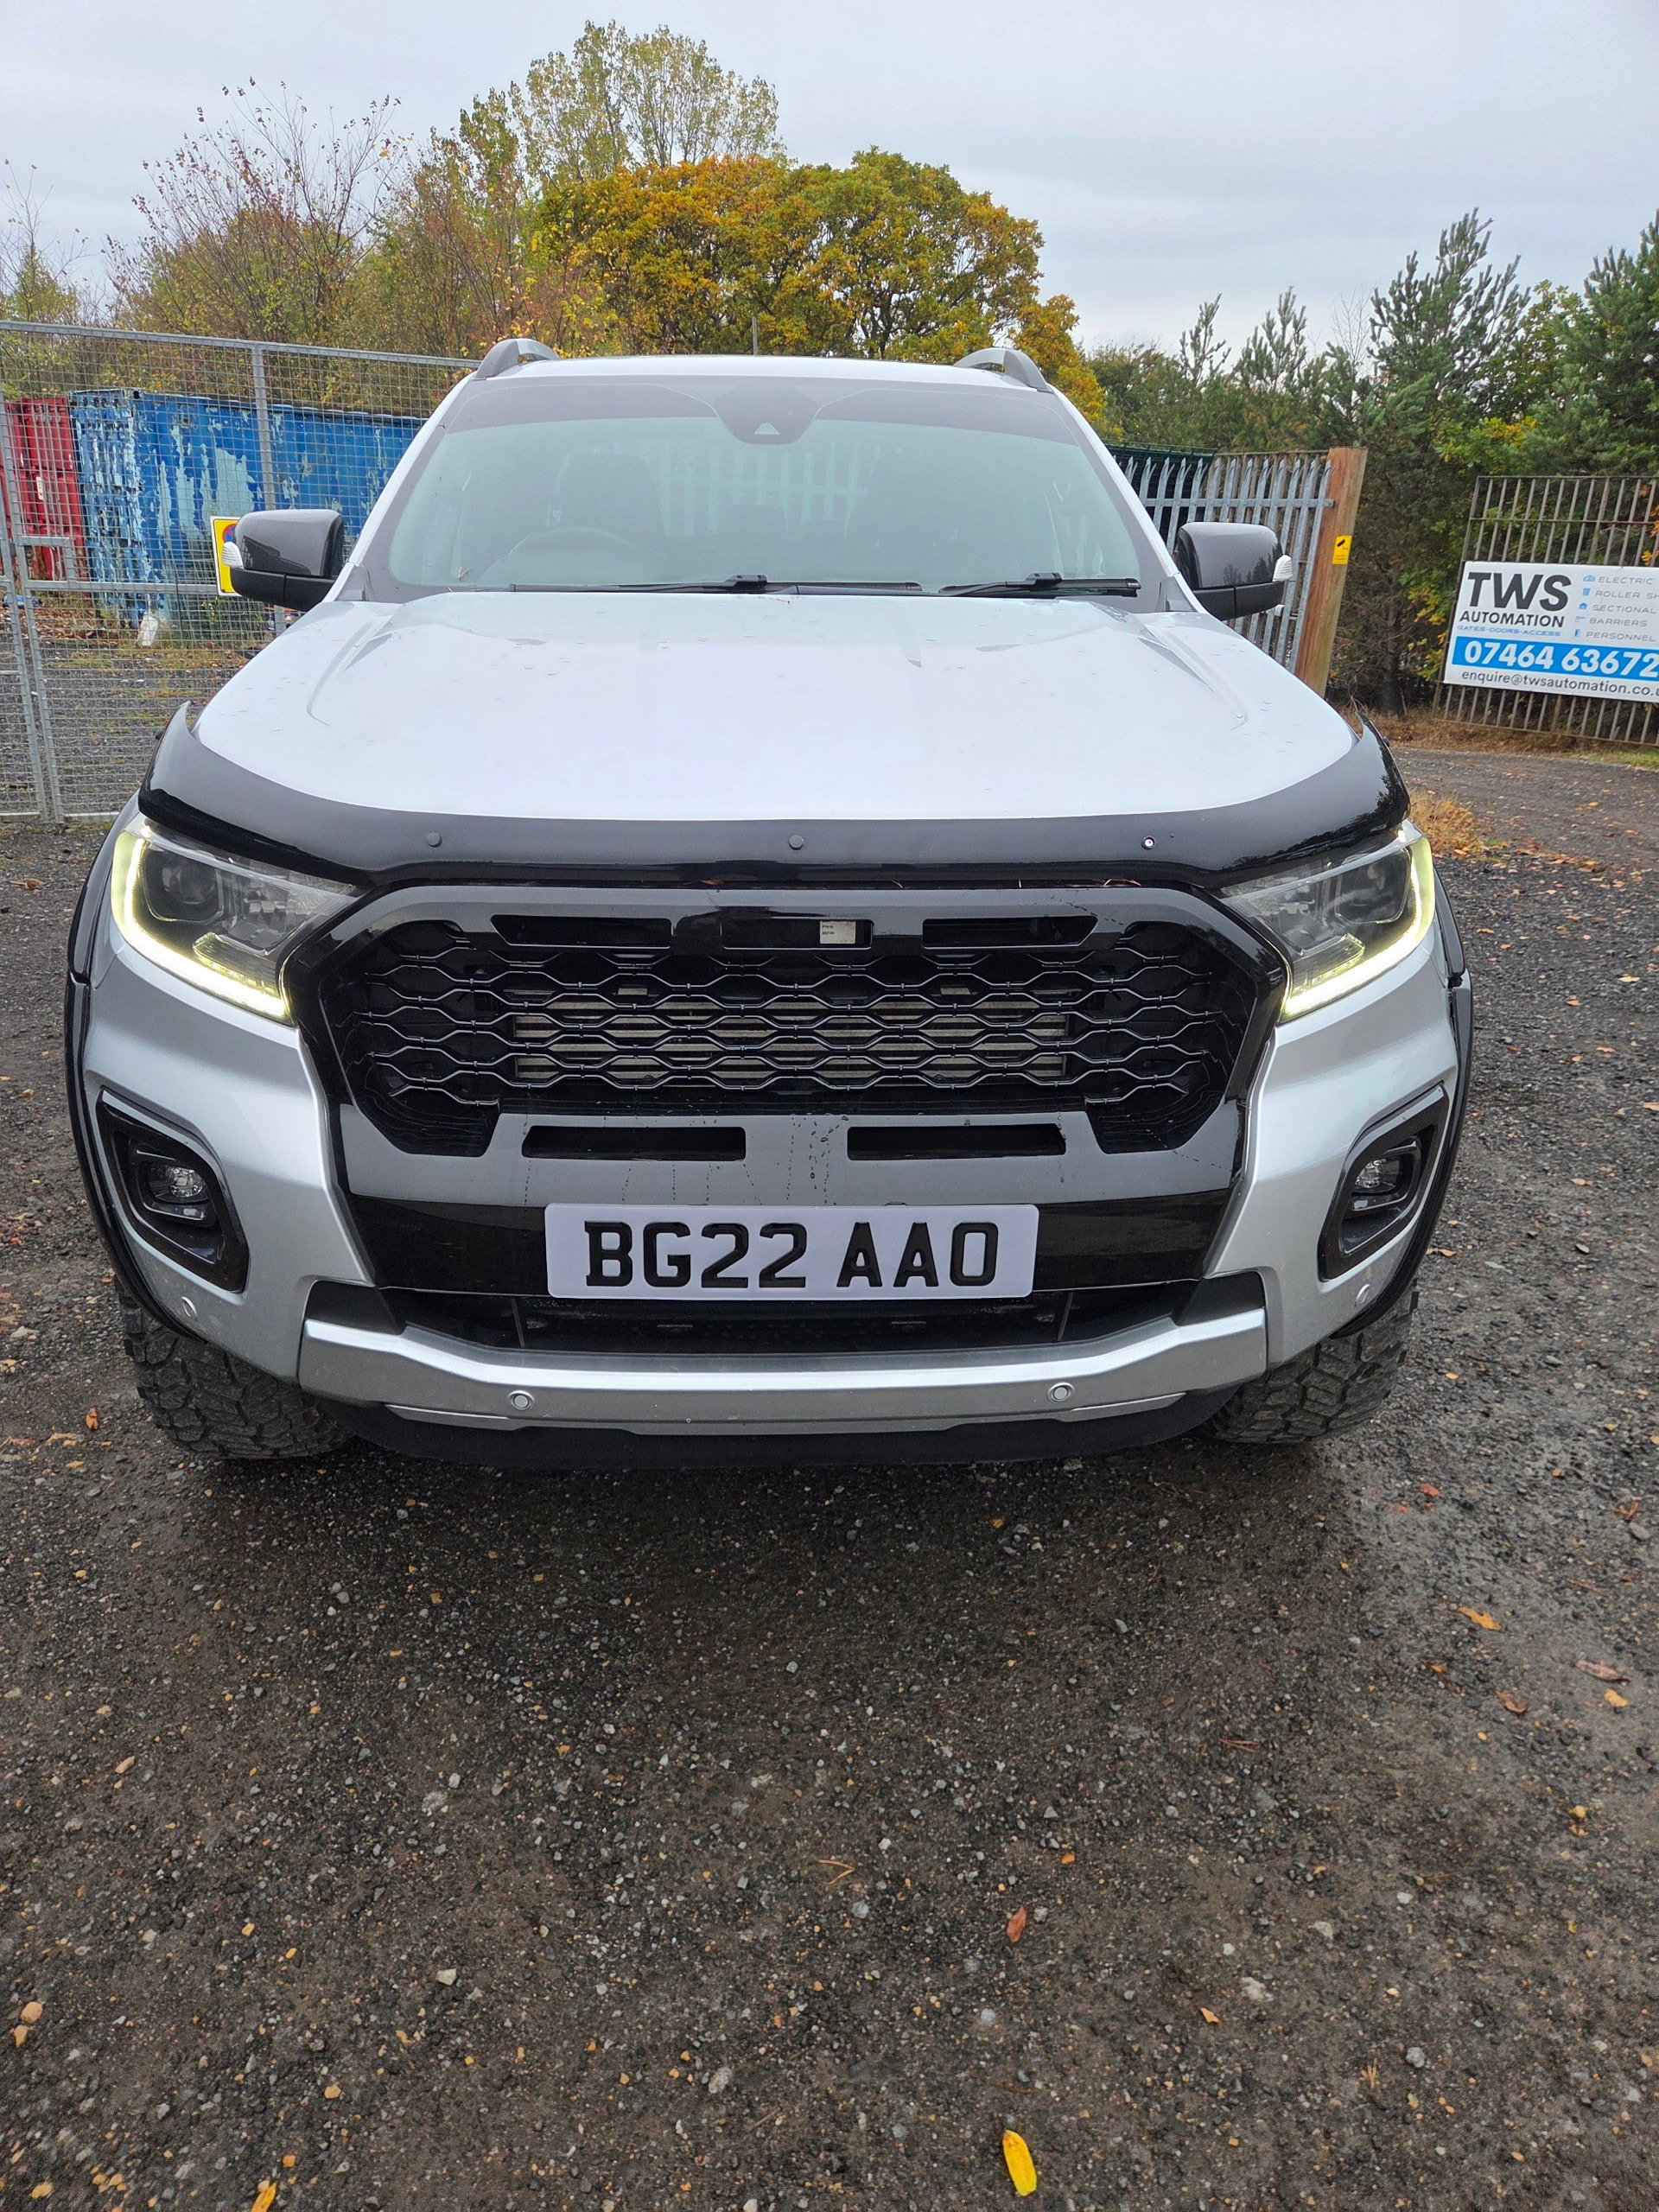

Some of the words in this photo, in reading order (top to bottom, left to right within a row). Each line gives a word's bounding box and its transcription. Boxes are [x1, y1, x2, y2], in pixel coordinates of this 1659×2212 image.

[1599, 576, 1654, 585] ELECTRIC
[1468, 572, 1572, 612] TWS
[1595, 590, 1640, 599] ROLLER
[1592, 604, 1656, 614] SECTIONAL
[1460, 611, 1565, 627] AUTOMATION
[1589, 617, 1648, 627] BARRIERS
[1586, 631, 1656, 642] PERSONNEL
[1465, 640, 1554, 670] 07464
[1561, 647, 1659, 677] 63672
[584, 1220, 806, 1288] BG22
